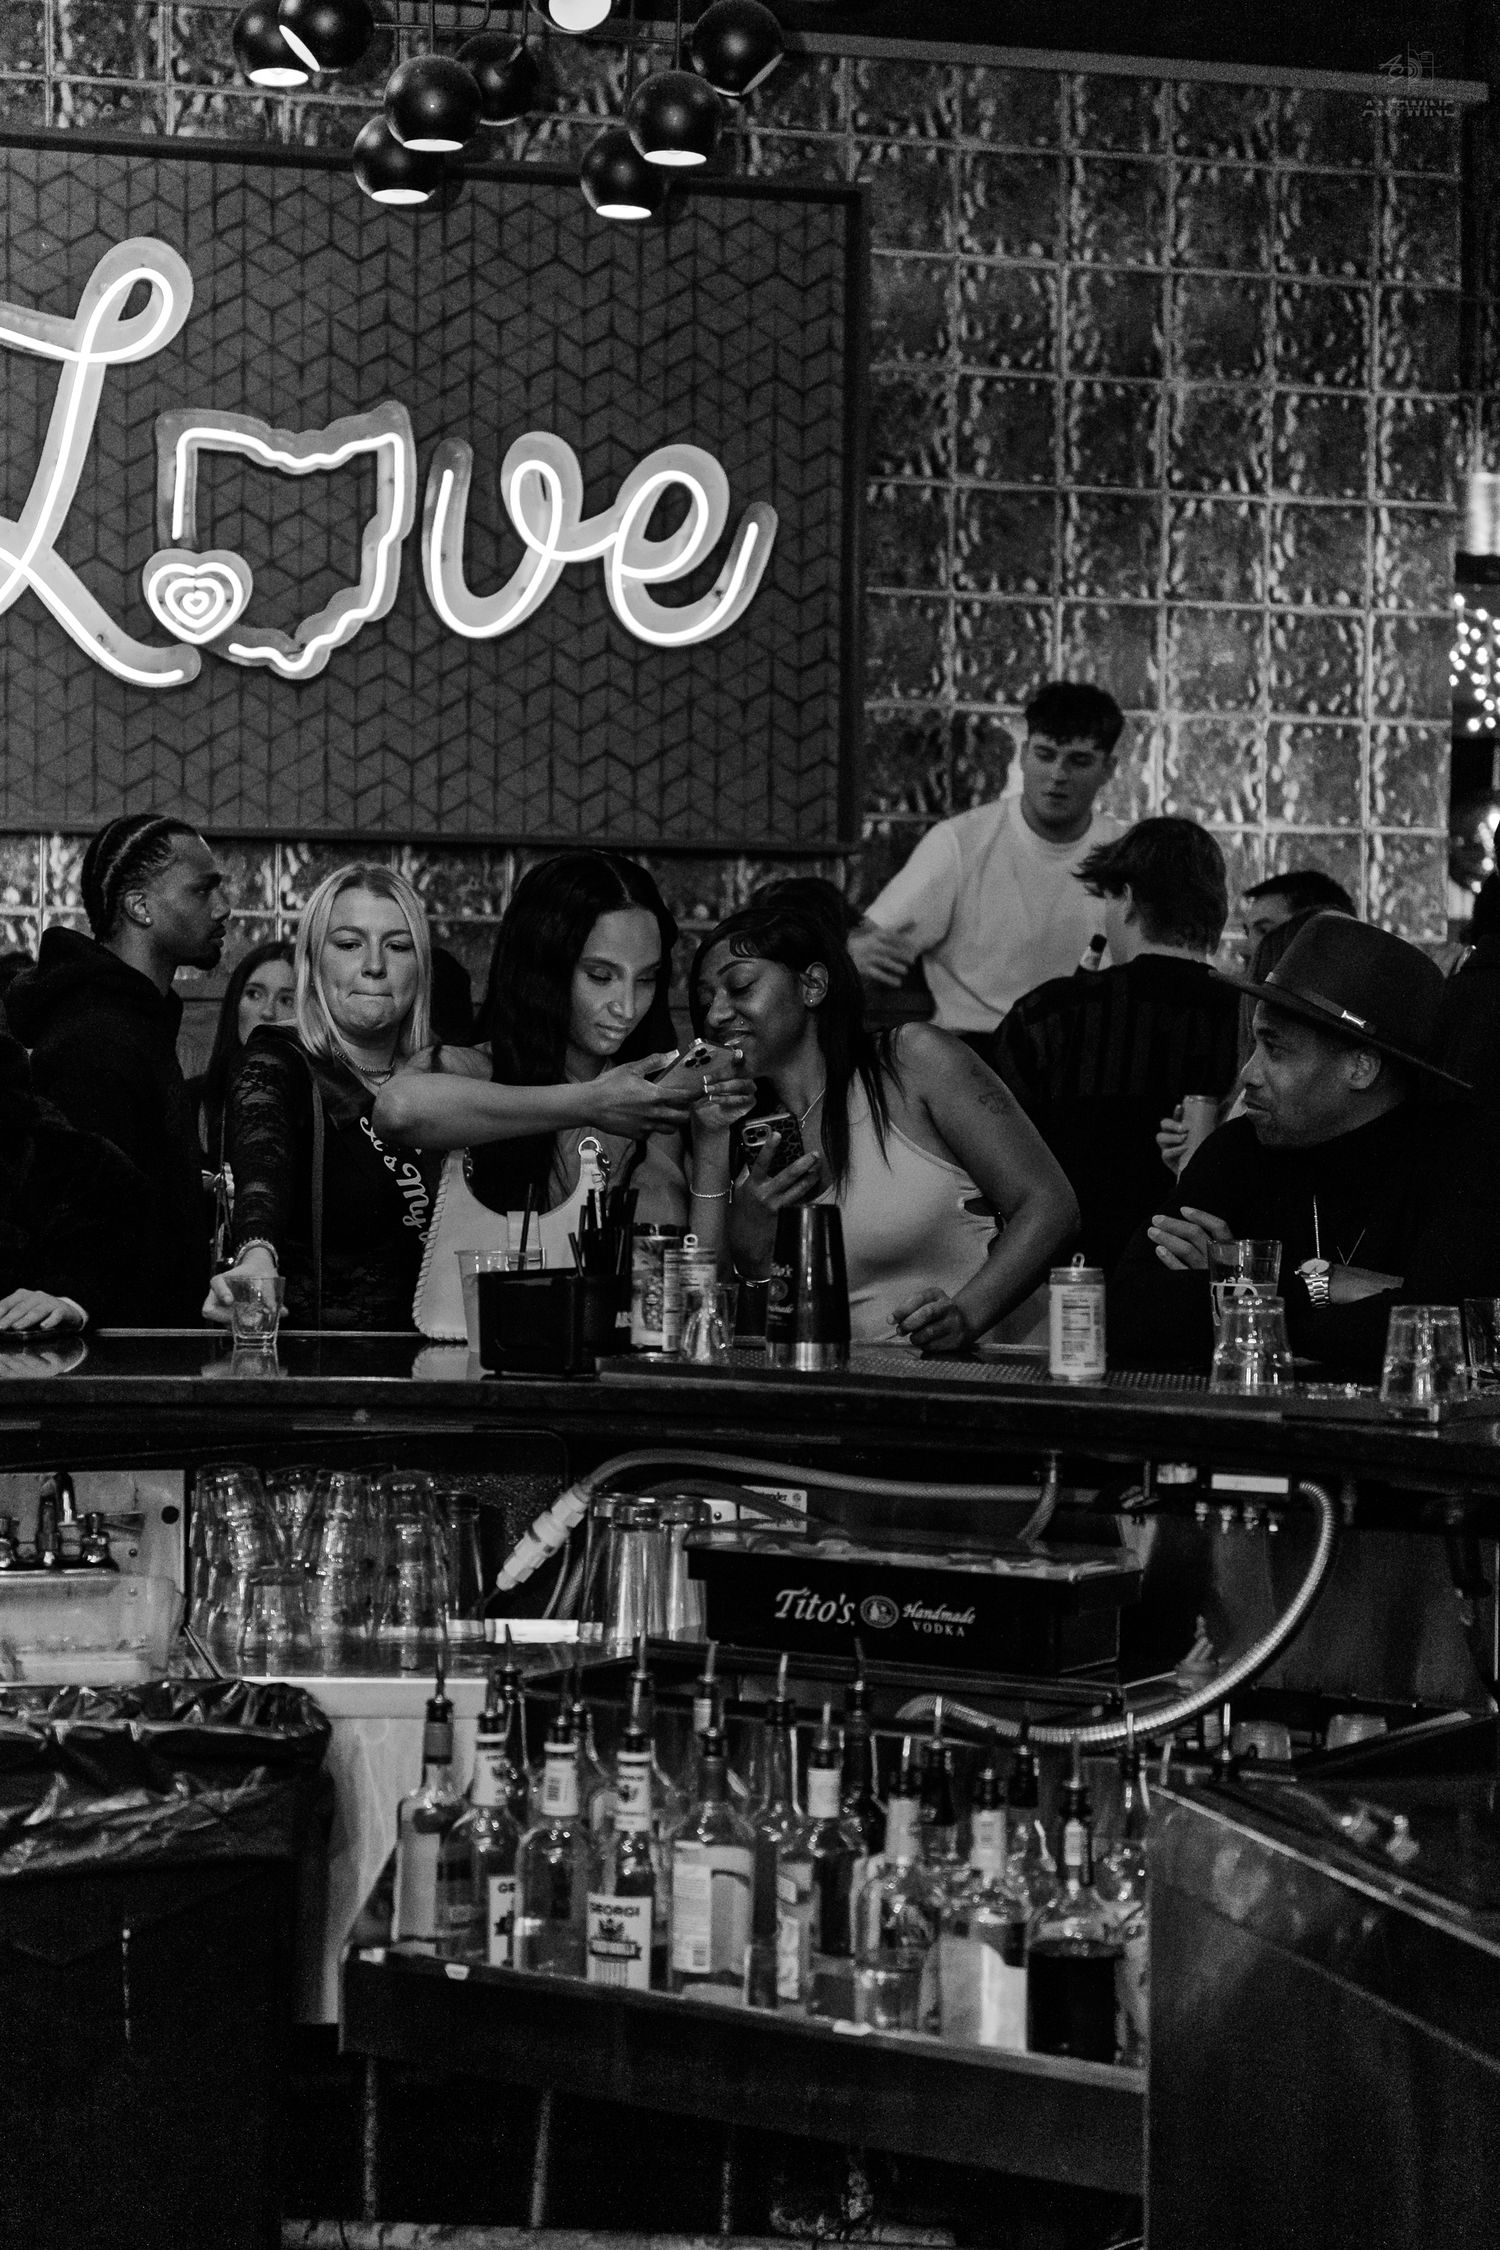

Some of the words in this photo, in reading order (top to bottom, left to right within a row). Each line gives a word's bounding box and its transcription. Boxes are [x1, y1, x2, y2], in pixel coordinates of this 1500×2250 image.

[395, 1162, 430, 1229] My
[774, 1586, 856, 1626] Tito's
[902, 1600, 977, 1625] Handmade
[912, 1621, 966, 1638] VODKA
